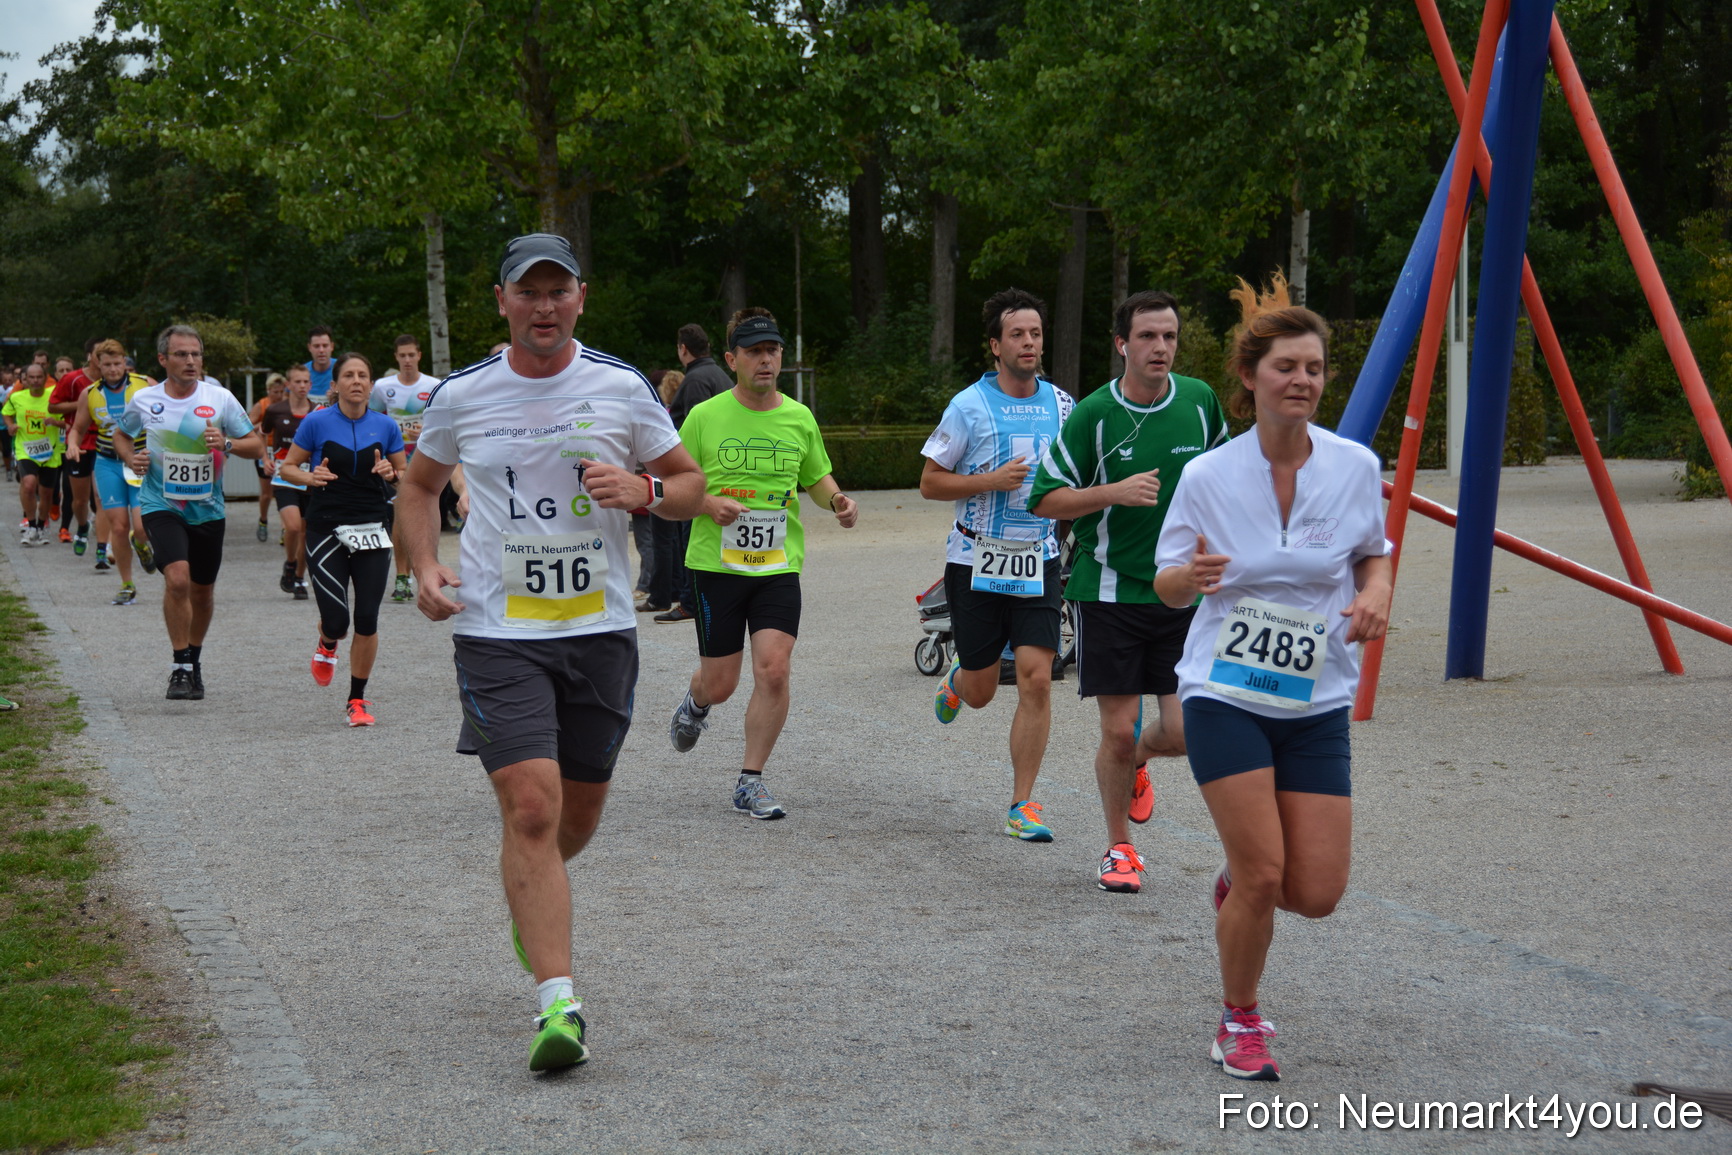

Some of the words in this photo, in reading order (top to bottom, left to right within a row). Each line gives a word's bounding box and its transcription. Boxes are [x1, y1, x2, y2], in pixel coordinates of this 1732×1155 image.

[1000, 405, 1050, 414] VIERTL
[31, 420, 41, 429] M
[484, 426, 527, 438] weidinger
[529, 422, 574, 435] versichert.
[28, 442, 50, 454] 2390
[718, 438, 800, 472] OPF
[1171, 446, 1195, 454] africon
[168, 464, 210, 482] 2815
[720, 488, 756, 498] MERZ
[736, 525, 774, 548] 351
[1294, 518, 1339, 548] Julia
[504, 544, 539, 554] PARTL
[542, 542, 590, 554] Neumarkt
[976, 540, 1000, 550] PARTL
[744, 554, 766, 564] Klaus
[980, 552, 1036, 578] 2700
[525, 556, 591, 594] 516
[990, 581, 1026, 592] Gerhard
[1262, 611, 1310, 631] Neumarkt
[1224, 620, 1316, 672] 2483
[1245, 672, 1280, 692] Julia
